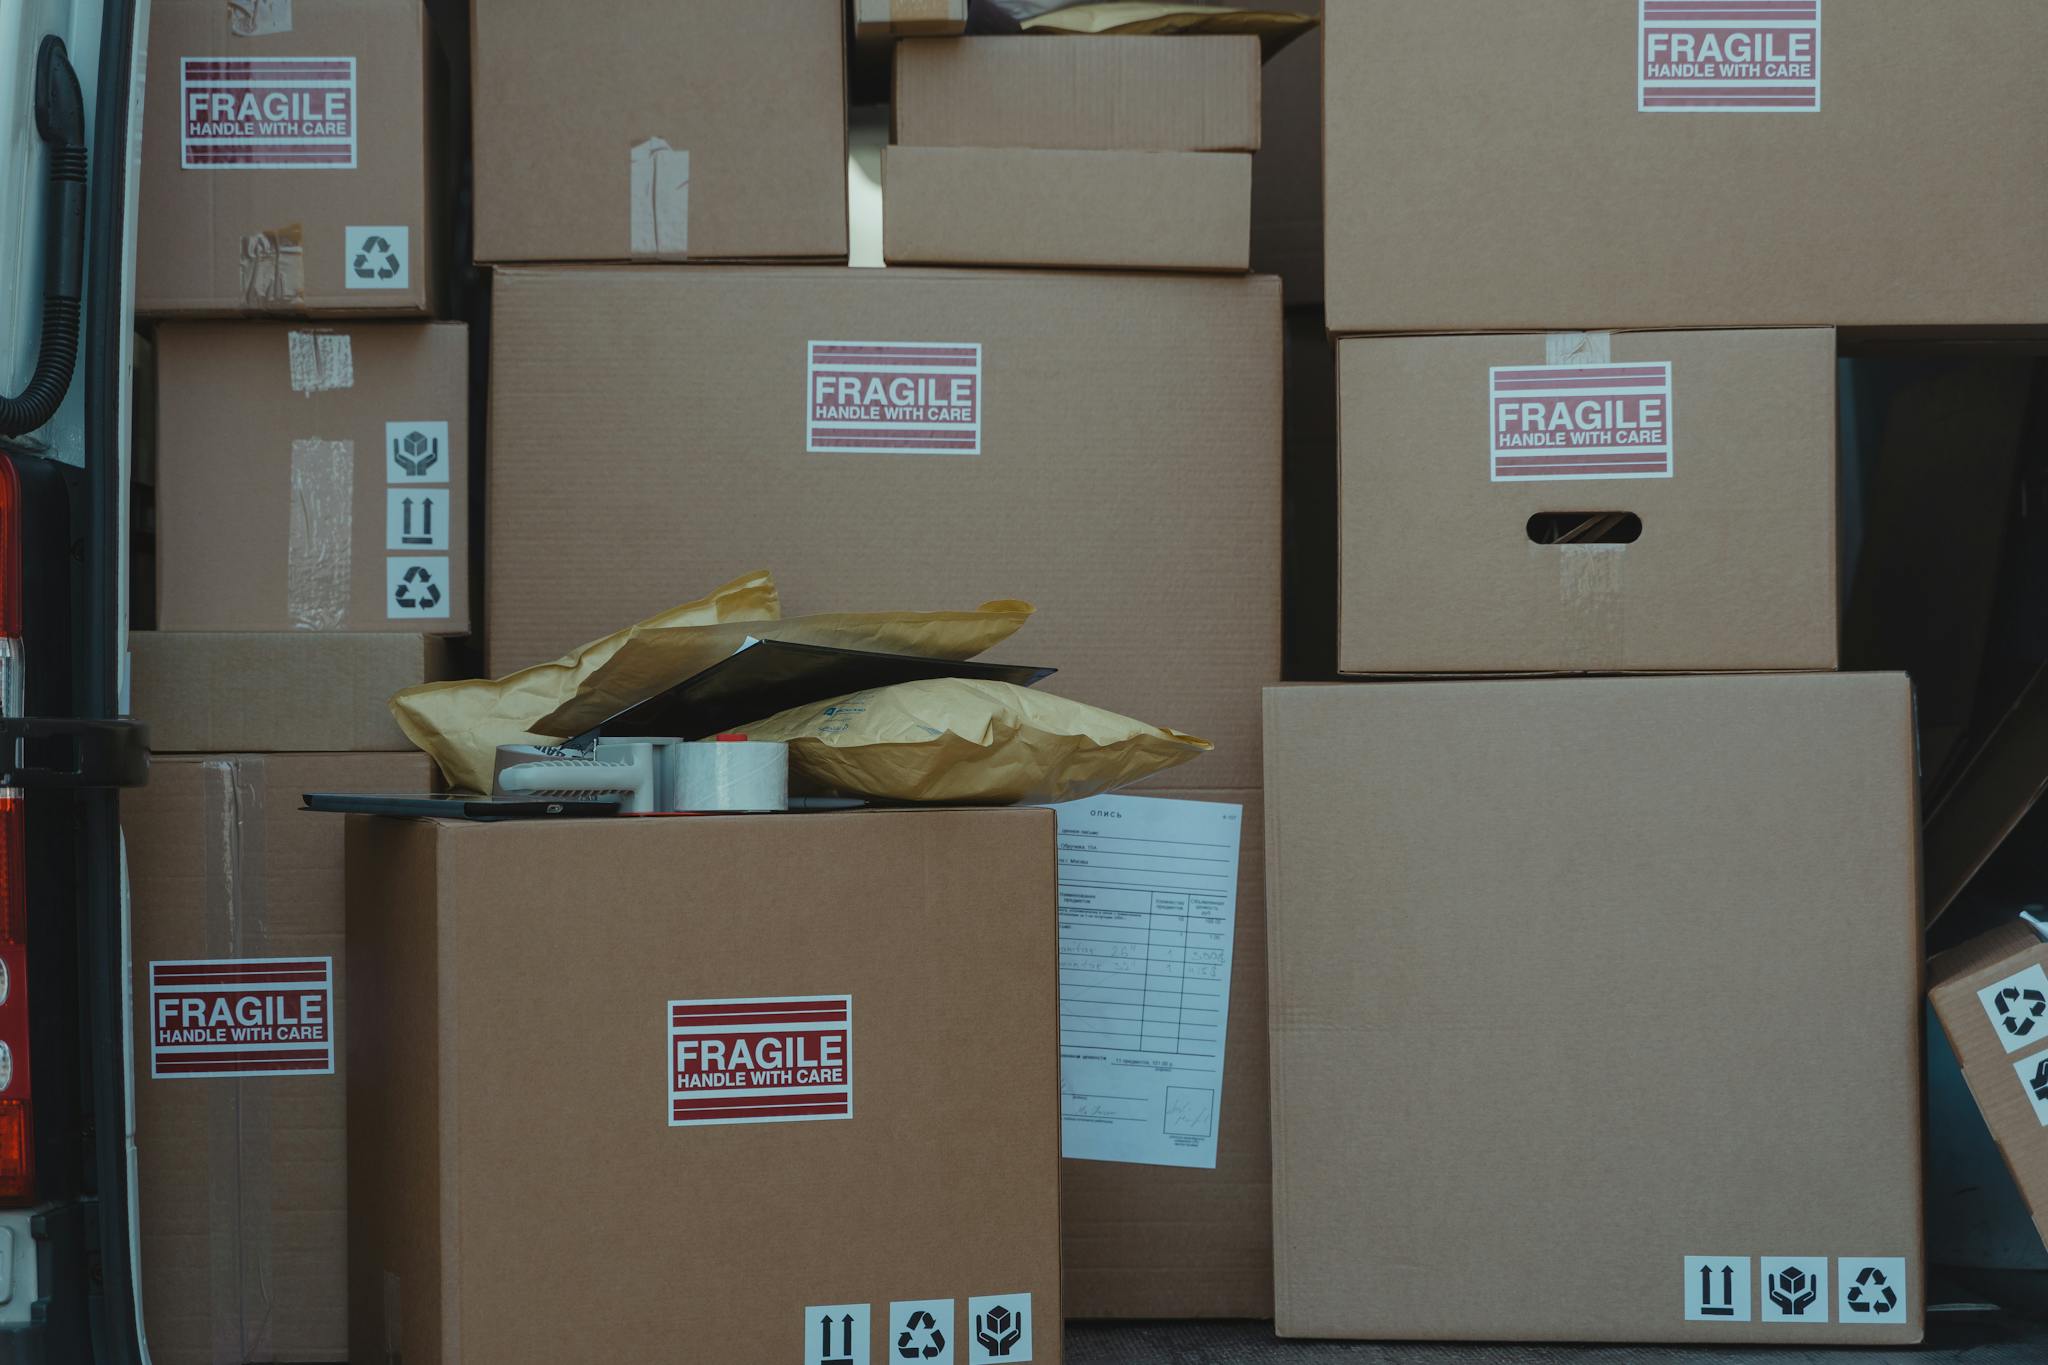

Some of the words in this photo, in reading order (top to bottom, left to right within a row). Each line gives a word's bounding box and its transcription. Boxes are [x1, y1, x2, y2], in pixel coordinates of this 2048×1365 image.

[1647, 32, 1811, 63] FRAGILE
[1648, 63, 1715, 77] HANDLE
[1719, 63, 1760, 77] WITH
[1765, 63, 1811, 77] CARE
[189, 92, 347, 121] FRAGILE
[190, 122, 255, 136] HANDLE
[258, 122, 298, 135] WITH
[303, 122, 347, 135] CARE
[815, 376, 972, 407] FRAGILE
[816, 407, 880, 420] HANDLE
[884, 407, 923, 421] WITH
[928, 408, 972, 421] CARE
[1498, 399, 1662, 432] FRAGILE
[1499, 432, 1566, 447] HANDLE
[1570, 431, 1612, 445] WITH
[1616, 430, 1662, 444] CARE
[158, 995, 323, 1028] FRAGILE
[160, 1028, 227, 1043] HANDLE
[231, 1027, 273, 1042] WITH
[277, 1026, 323, 1040] CARE
[677, 1036, 843, 1072] FRAGILE
[677, 1072, 746, 1088] HANDLE
[750, 1071, 792, 1086] WITH
[797, 1069, 843, 1084] CARE
